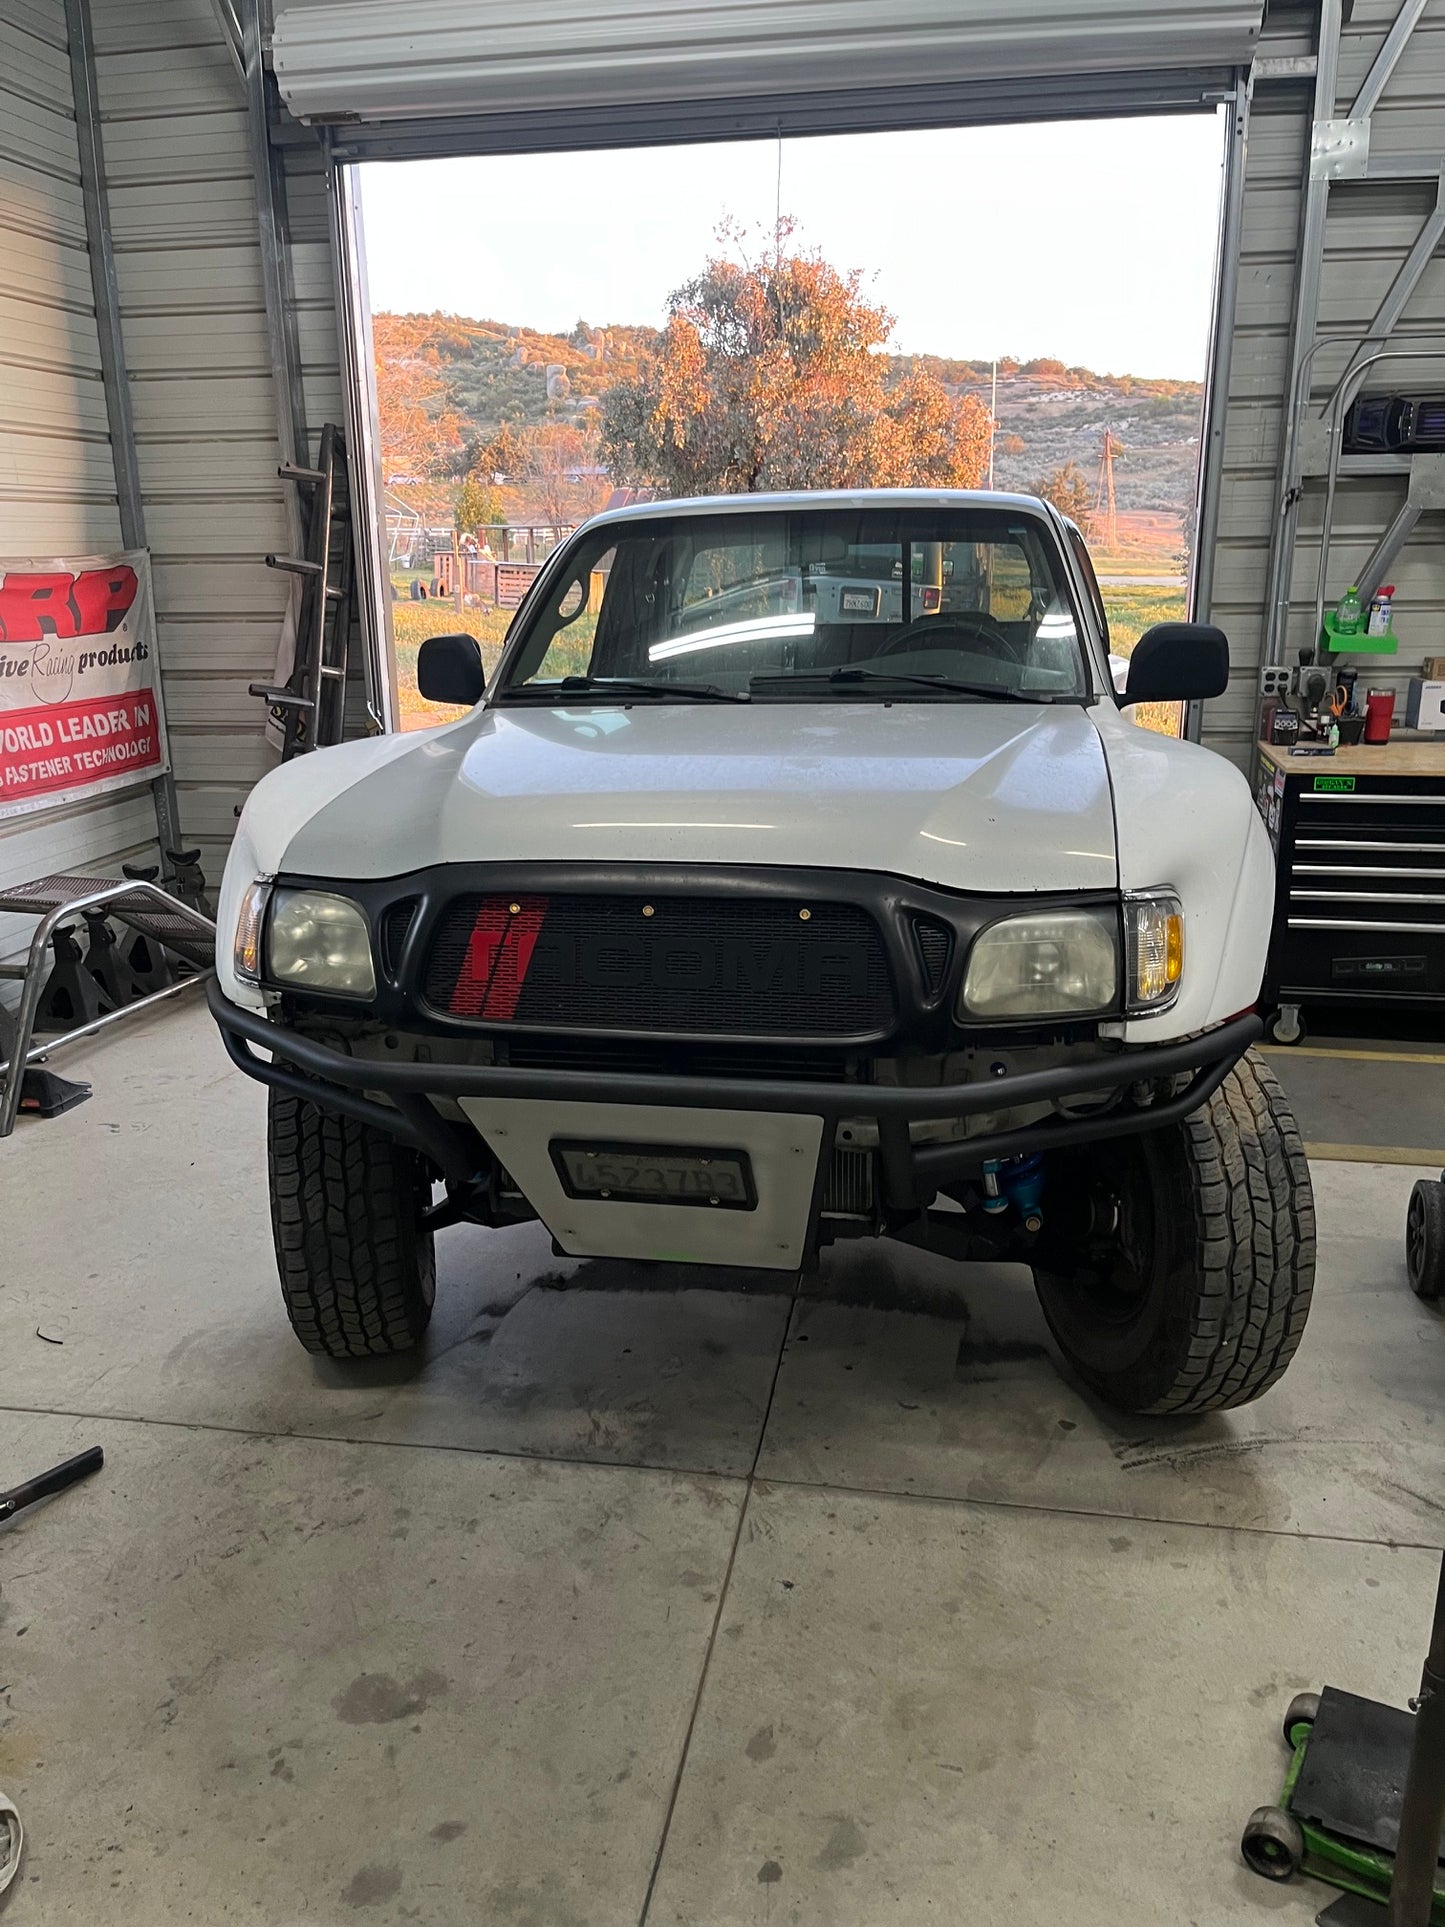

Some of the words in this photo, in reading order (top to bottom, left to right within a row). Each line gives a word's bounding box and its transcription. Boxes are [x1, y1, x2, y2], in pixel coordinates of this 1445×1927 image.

[0, 565, 138, 642] RP
[0, 655, 30, 677] ive
[30, 643, 75, 704] Racing
[78, 641, 149, 674] products
[0, 722, 54, 753] ORLD
[57, 709, 132, 743] LEADER
[134, 704, 150, 727] IN
[5, 756, 74, 785] FASTENER
[73, 736, 151, 770] TECHNOLOGY
[448, 929, 869, 997] TACOMA
